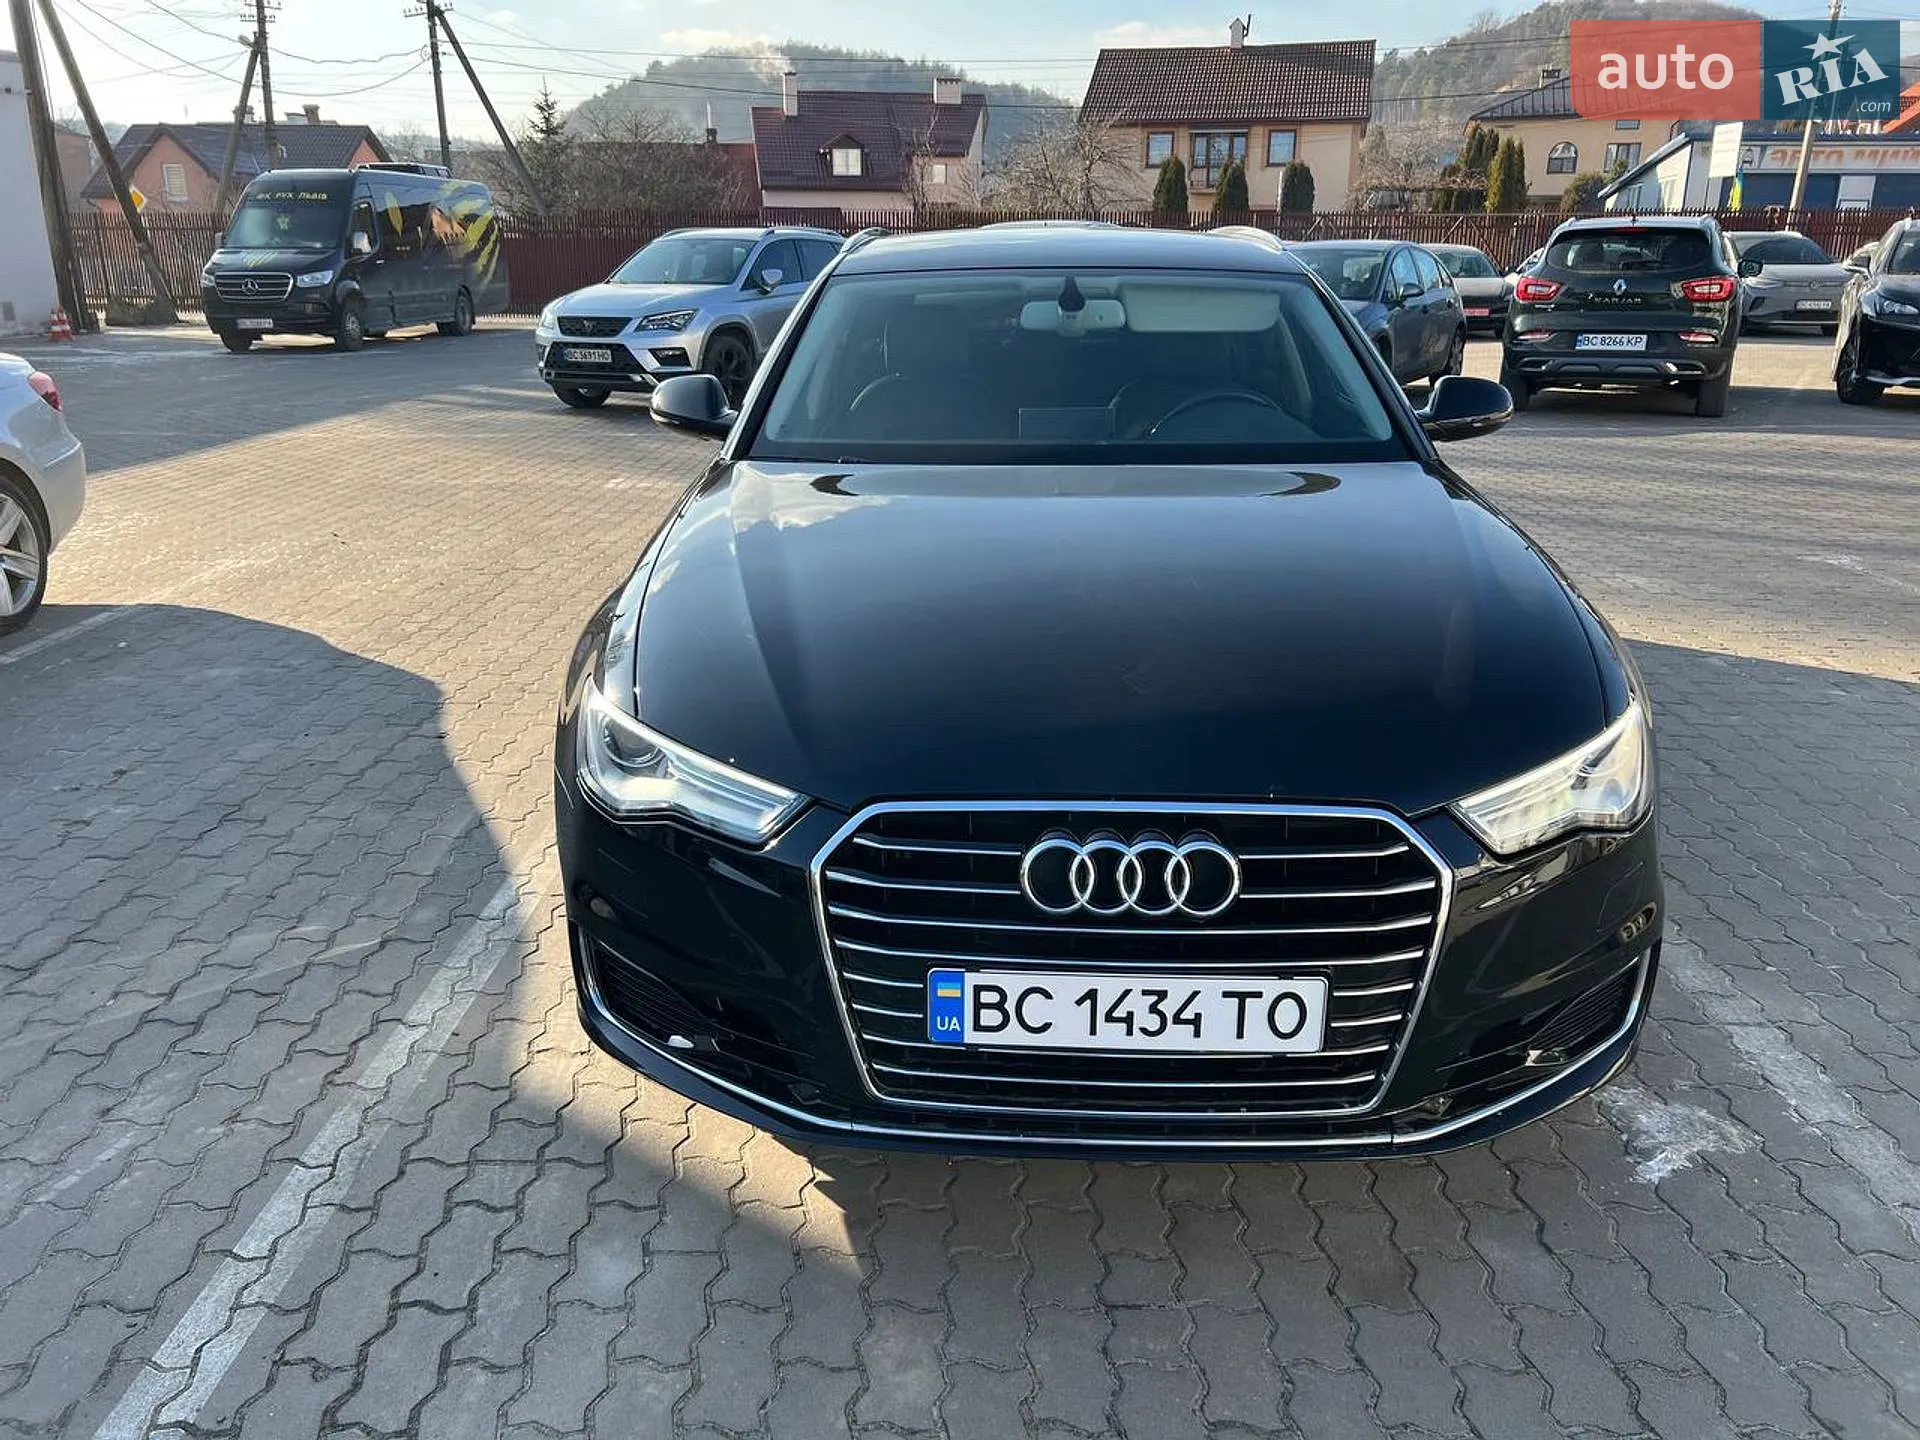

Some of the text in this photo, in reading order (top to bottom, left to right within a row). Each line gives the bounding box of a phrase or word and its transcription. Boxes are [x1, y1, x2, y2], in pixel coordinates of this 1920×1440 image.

[1583, 336, 1644, 346] BC 8266 KP
[972, 983, 1308, 1040] BC 1434 TO
[936, 1015, 961, 1033] UA
